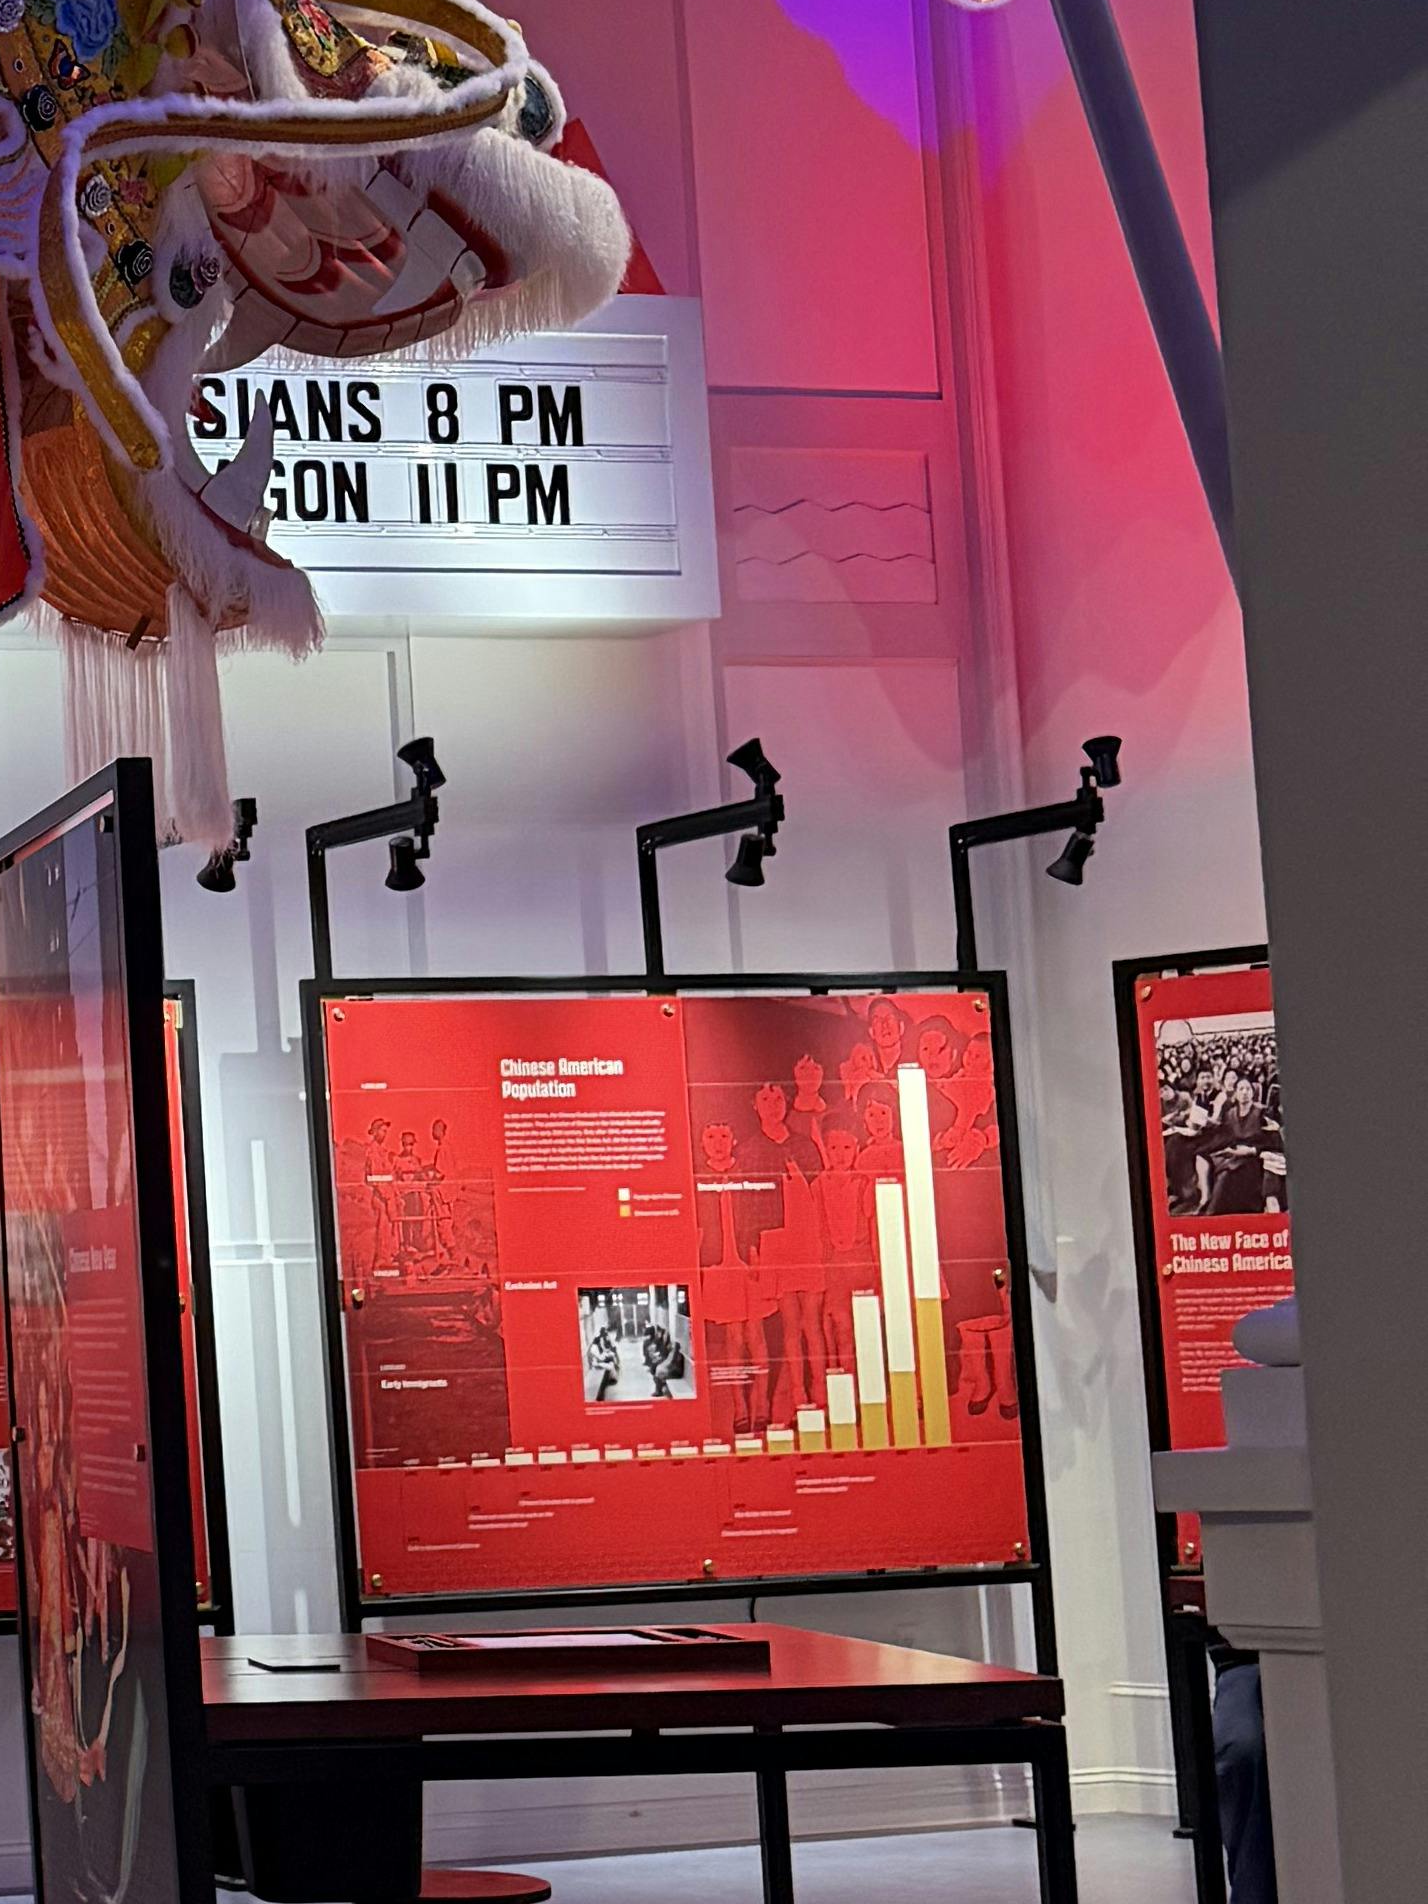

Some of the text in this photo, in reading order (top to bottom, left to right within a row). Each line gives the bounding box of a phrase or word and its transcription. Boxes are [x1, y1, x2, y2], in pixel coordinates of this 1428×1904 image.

[427, 383, 460, 446] 8
[499, 384, 584, 447] PM
[216, 459, 370, 524] GON
[486, 464, 571, 526] PM
[500, 1057, 624, 1077] Chinese American
[501, 1079, 577, 1101] Population
[1170, 1228, 1289, 1252] The New Face of
[1172, 1252, 1293, 1273] Chinese America
[380, 1379, 402, 1390] Early
